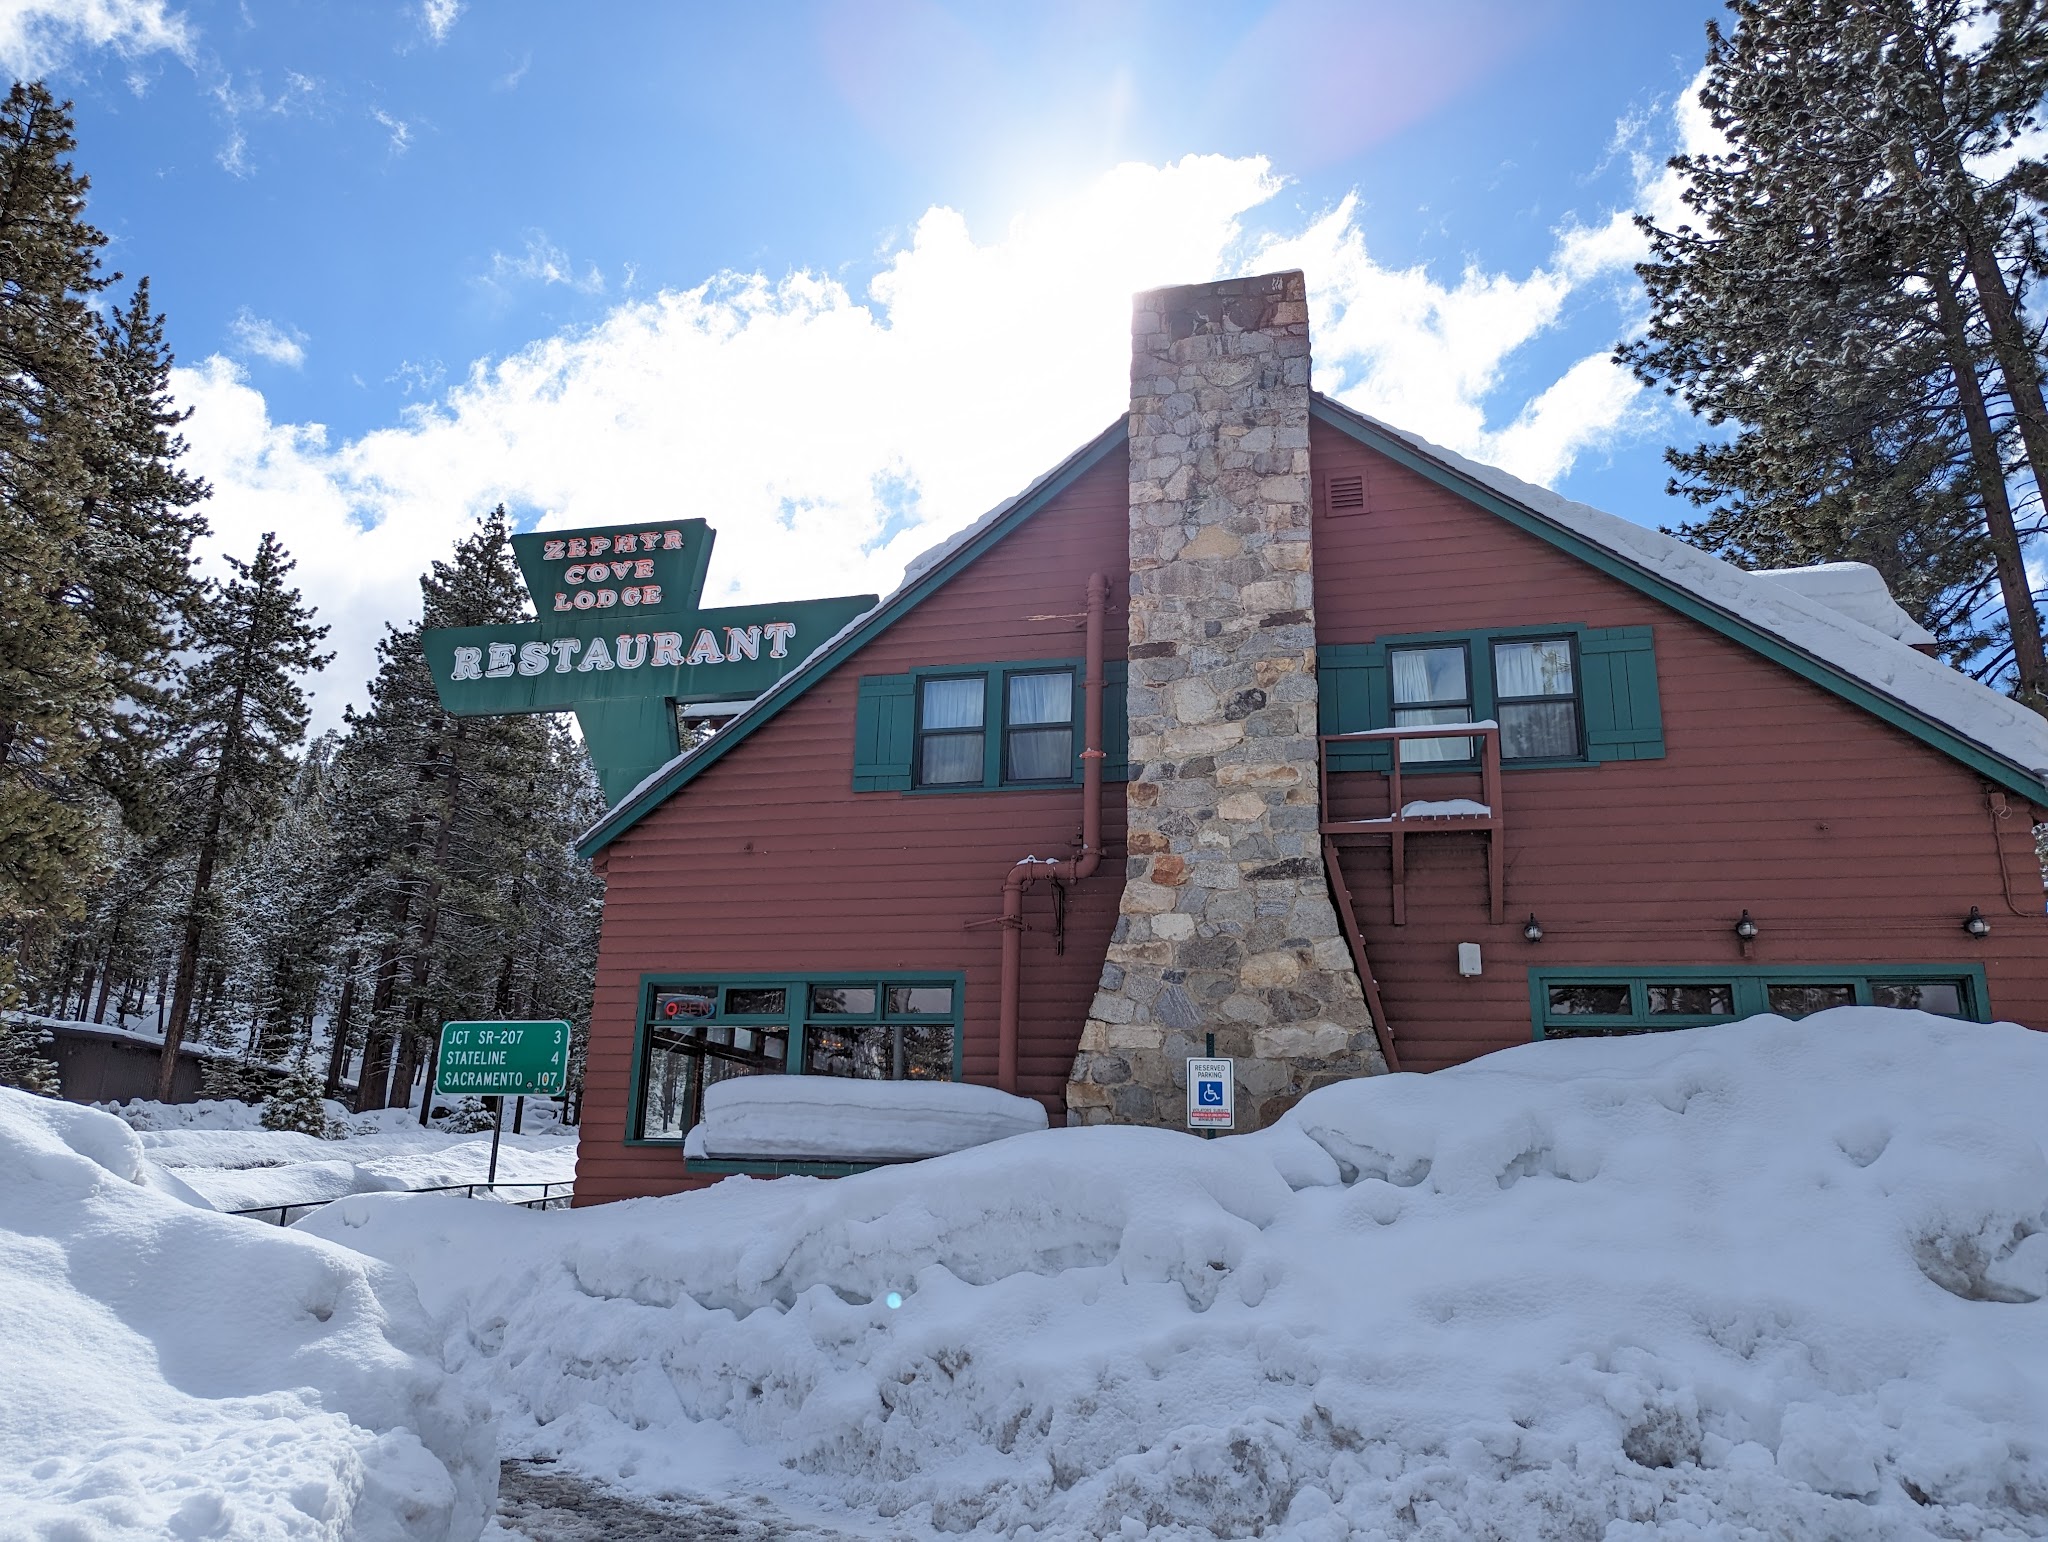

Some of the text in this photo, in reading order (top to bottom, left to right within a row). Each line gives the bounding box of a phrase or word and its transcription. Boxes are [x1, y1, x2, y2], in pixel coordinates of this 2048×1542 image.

[543, 530, 684, 560] ZEPHYR
[564, 559, 654, 585] COVE
[554, 585, 662, 611] LODGE
[451, 622, 796, 681] RESTAURANT
[665, 1002, 709, 1016] OPEN
[448, 1030, 562, 1045] JCT SR-207 3
[446, 1051, 559, 1065] STATELINE 4
[444, 1071, 558, 1086] SACRAMENTO 107
